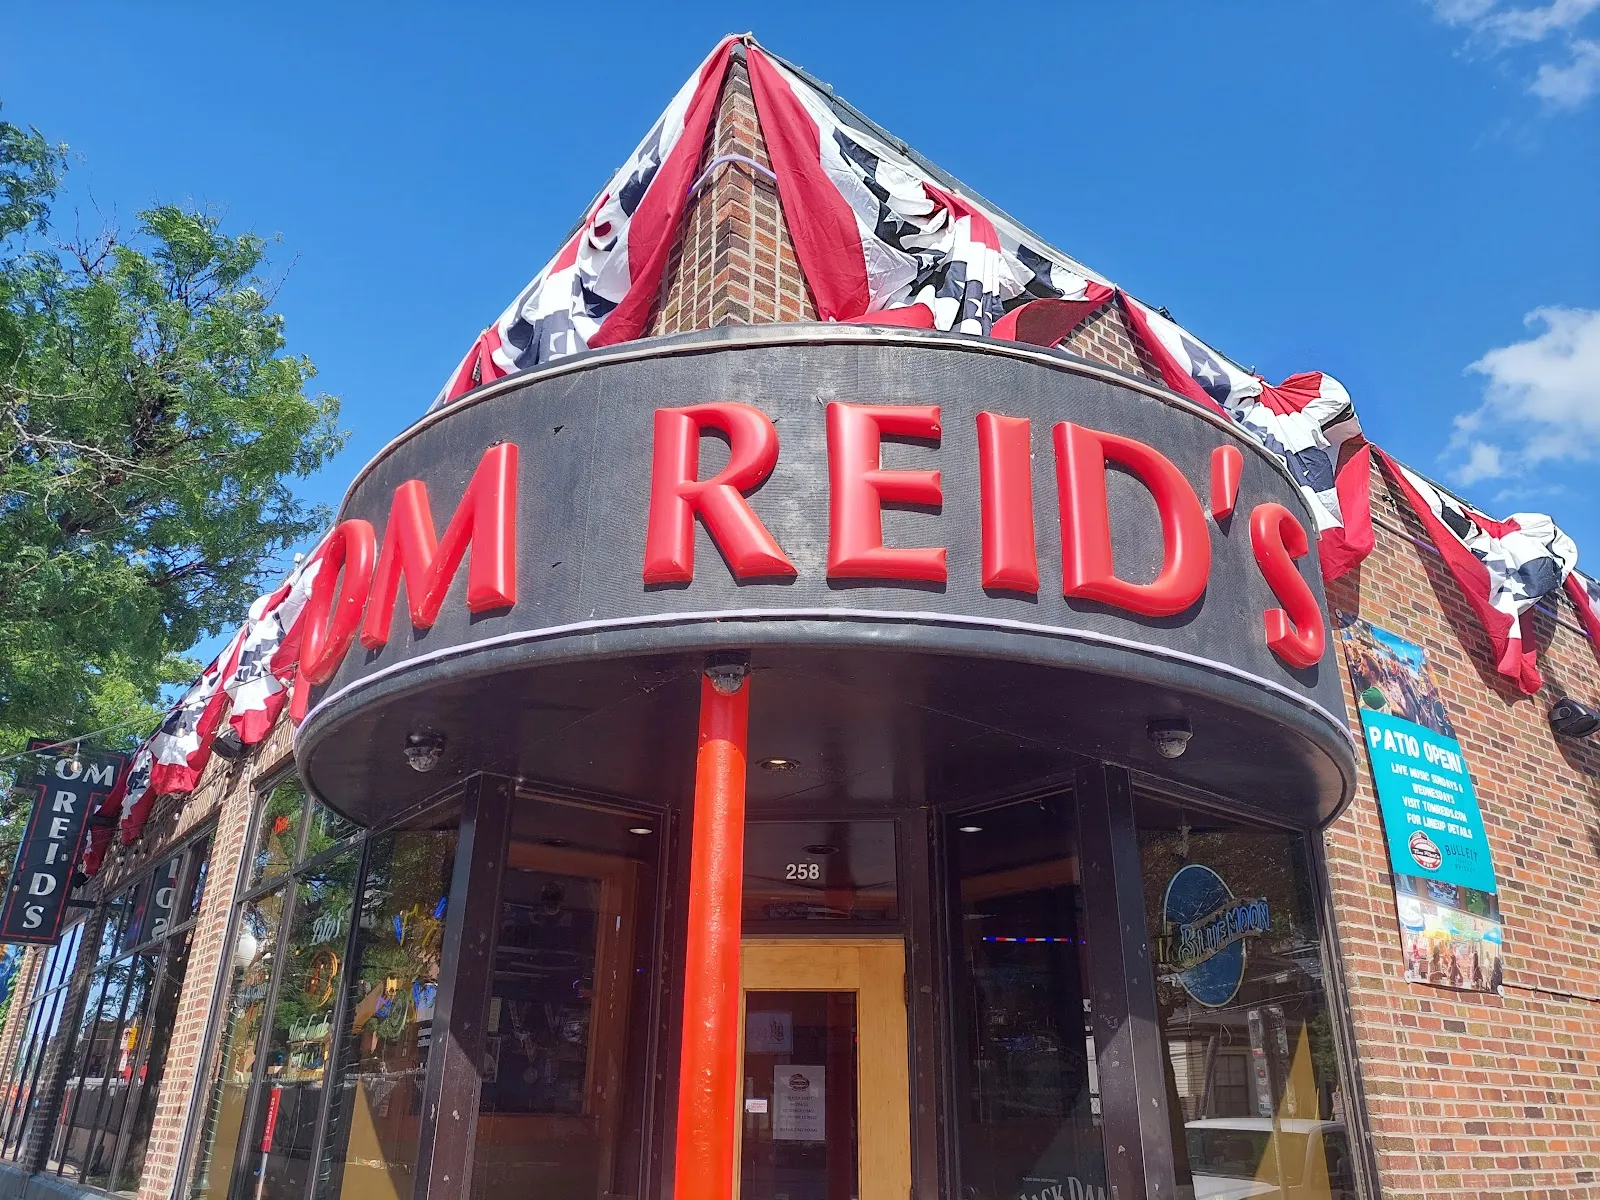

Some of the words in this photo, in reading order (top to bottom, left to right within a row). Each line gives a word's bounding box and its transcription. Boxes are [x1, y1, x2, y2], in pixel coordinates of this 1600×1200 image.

[289, 442, 519, 727] OM
[1368, 725, 1420, 759] PATIO
[1423, 741, 1463, 775] OPEN!
[1391, 762, 1409, 777] LIVE
[1409, 766, 1430, 782] MUSIC
[1431, 773, 1458, 792] SUNDAYS
[1459, 783, 1464, 793] &
[1412, 783, 1455, 804] WEDNESDAYS
[1402, 796, 1421, 810] VISIT
[1422, 801, 1468, 823] TOMREIDS.COM
[1406, 812, 1422, 826] FOR
[1422, 816, 1446, 831] LINEUP
[1447, 822, 1473, 839] DETAILS
[1445, 844, 1478, 862] BULLEIT
[786, 863, 820, 880] 258
